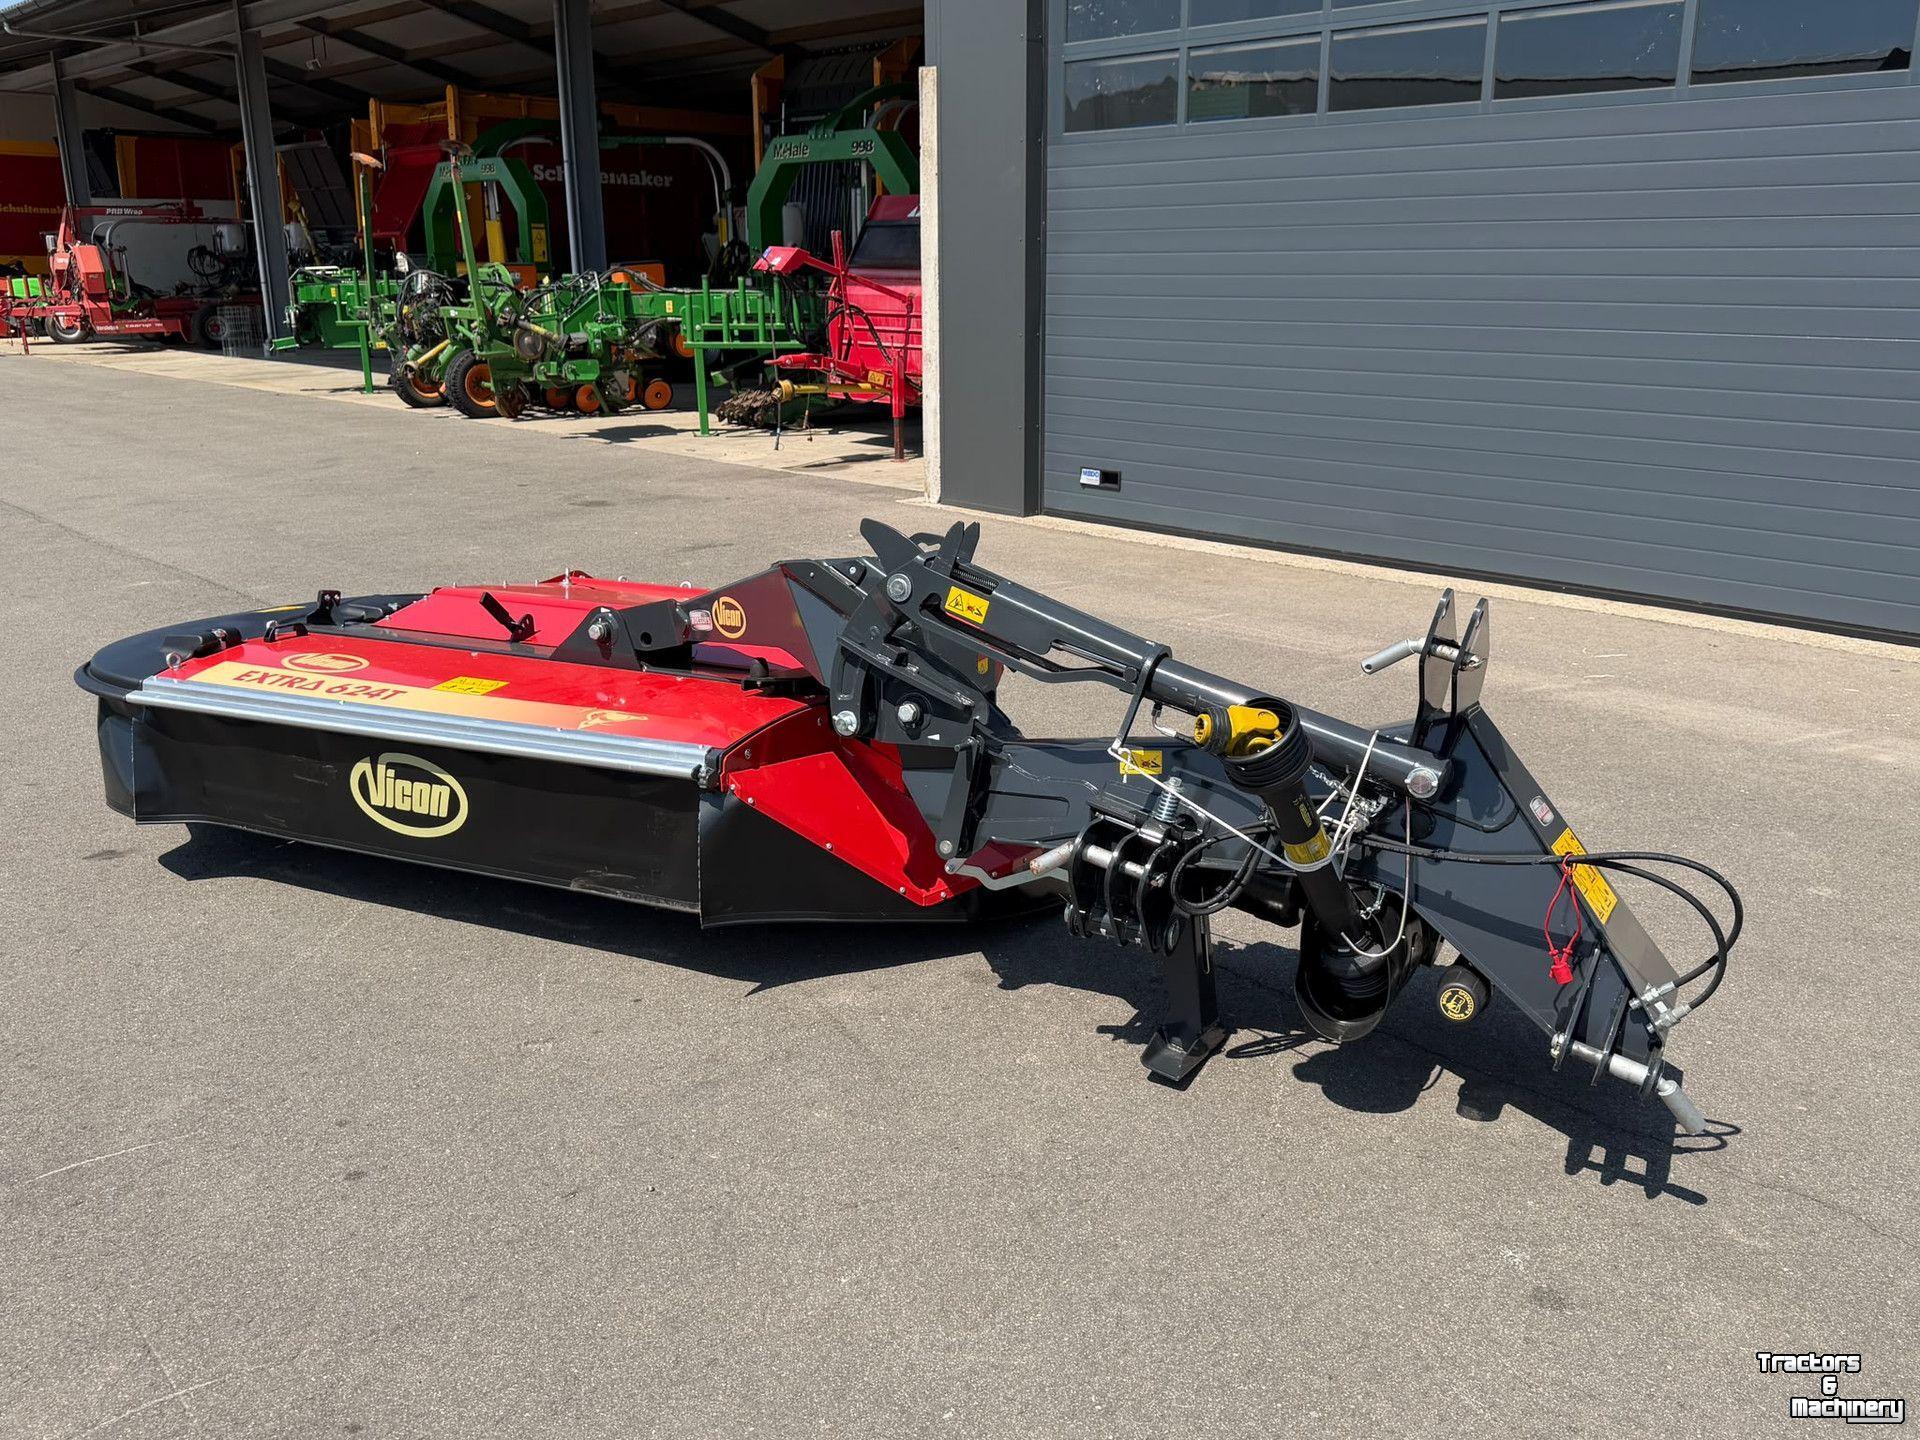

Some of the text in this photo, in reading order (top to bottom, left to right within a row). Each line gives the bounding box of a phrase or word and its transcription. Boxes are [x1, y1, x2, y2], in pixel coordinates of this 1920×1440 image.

[774, 141, 875, 159] McHale 998
[533, 164, 673, 187] Schemaker
[233, 670, 407, 700] EXTRA 624T
[364, 755, 451, 818] Vicon
